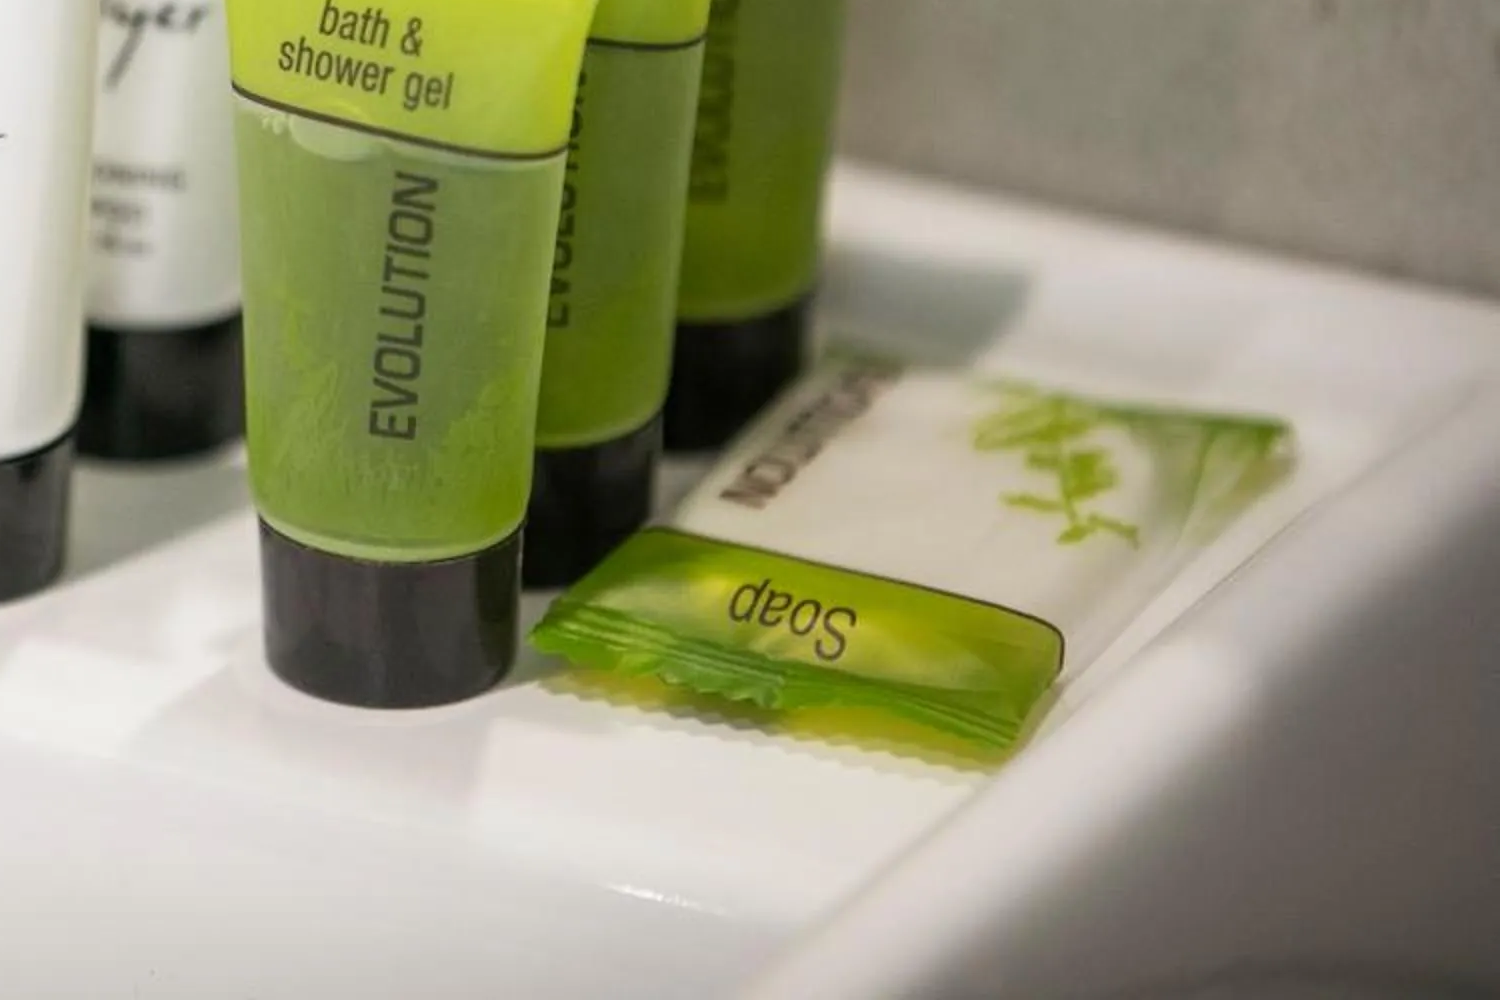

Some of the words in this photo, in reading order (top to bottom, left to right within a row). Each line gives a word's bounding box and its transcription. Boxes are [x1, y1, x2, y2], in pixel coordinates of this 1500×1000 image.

[278, 35, 395, 95] shower
[403, 71, 455, 112] gel
[400, 16, 423, 57] &
[368, 170, 440, 441] EVOLUTION
[728, 577, 858, 662] Soap
